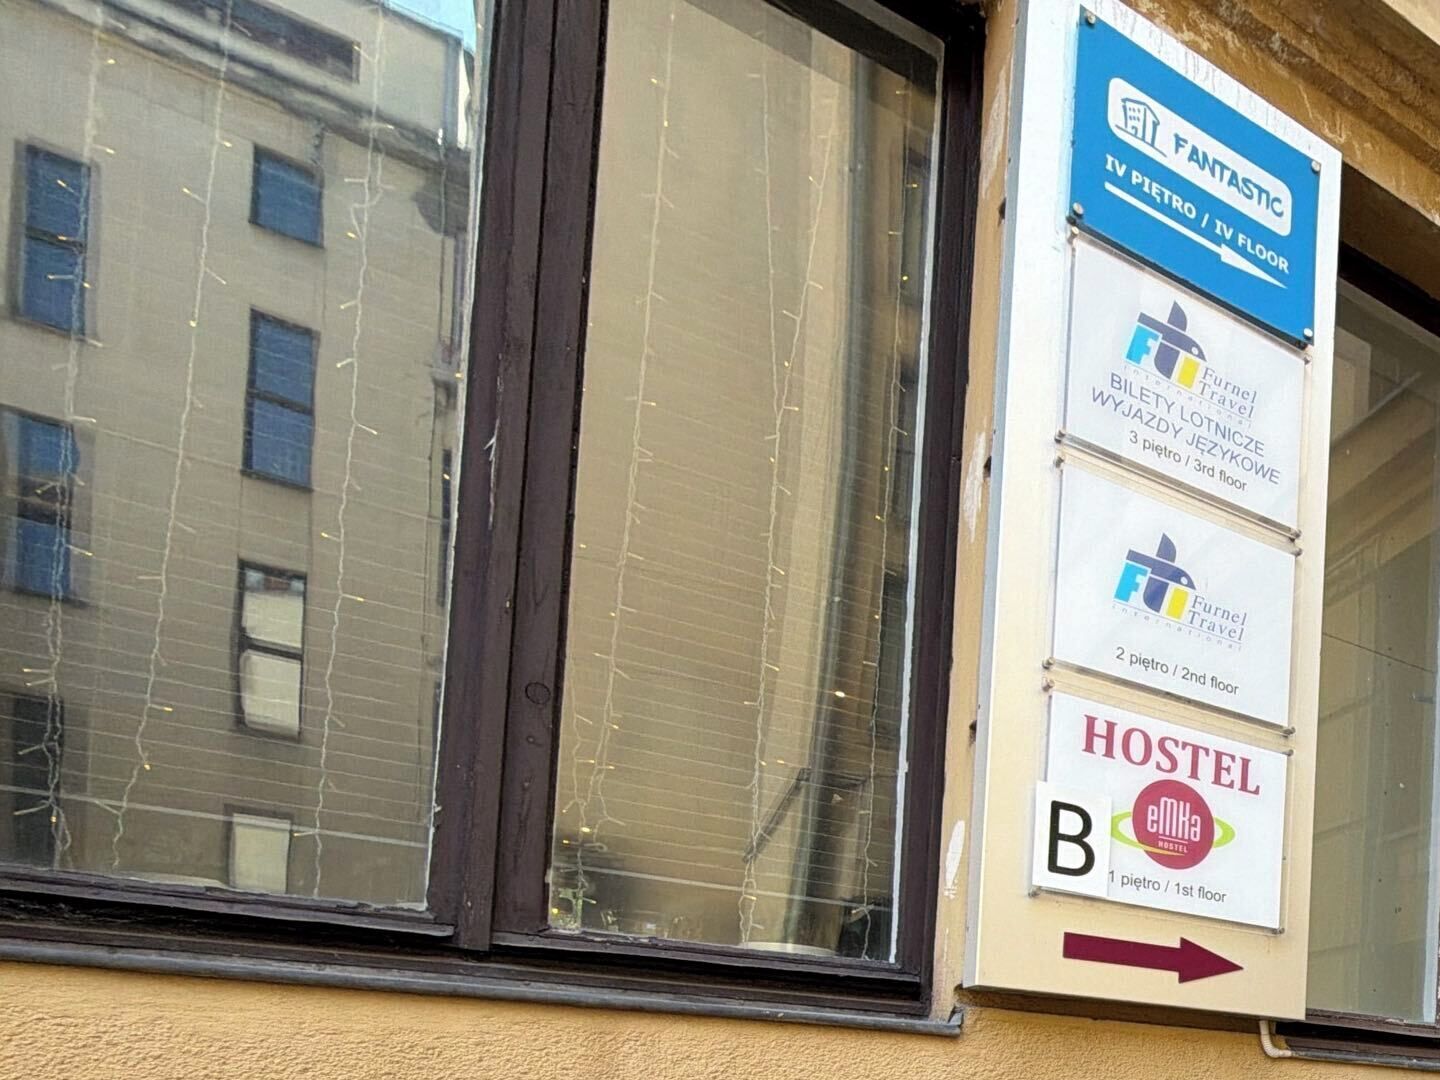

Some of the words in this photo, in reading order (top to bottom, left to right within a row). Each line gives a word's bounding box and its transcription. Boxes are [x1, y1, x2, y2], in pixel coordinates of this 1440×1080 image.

[1173, 132, 1285, 219] FANTASTIC
[1105, 153, 1126, 177] IV
[1131, 168, 1198, 220] PIĘTRO
[1201, 212, 1209, 229] /
[1215, 220, 1234, 242] IV
[1238, 235, 1290, 275] FLOOR
[1199, 380, 1254, 419] Travel
[1202, 367, 1257, 404] Furnel
[1091, 386, 1184, 439] WYJAZDY
[1186, 432, 1281, 485] JĘZYKOWE
[1110, 372, 1176, 414] BILETY
[1180, 405, 1265, 457] LOTNICZE
[1129, 430, 1138, 444] 3
[1142, 438, 1182, 464] piętro
[1193, 457, 1215, 478] 3rd
[1218, 465, 1248, 492] floor
[1188, 609, 1244, 641] Travel
[1191, 594, 1247, 626] Furnel
[1115, 646, 1125, 660] 2
[1129, 652, 1169, 674] piętro
[1181, 666, 1207, 686] 2nd
[1210, 675, 1240, 695] floor
[1081, 714, 1261, 796] HOSTEL
[1047, 799, 1096, 877] B
[1158, 840, 1188, 853] HOSTEL
[1108, 869, 1115, 883] 1
[1120, 873, 1161, 892] piętro
[1174, 881, 1194, 898] 1st
[1197, 885, 1228, 903] floor
